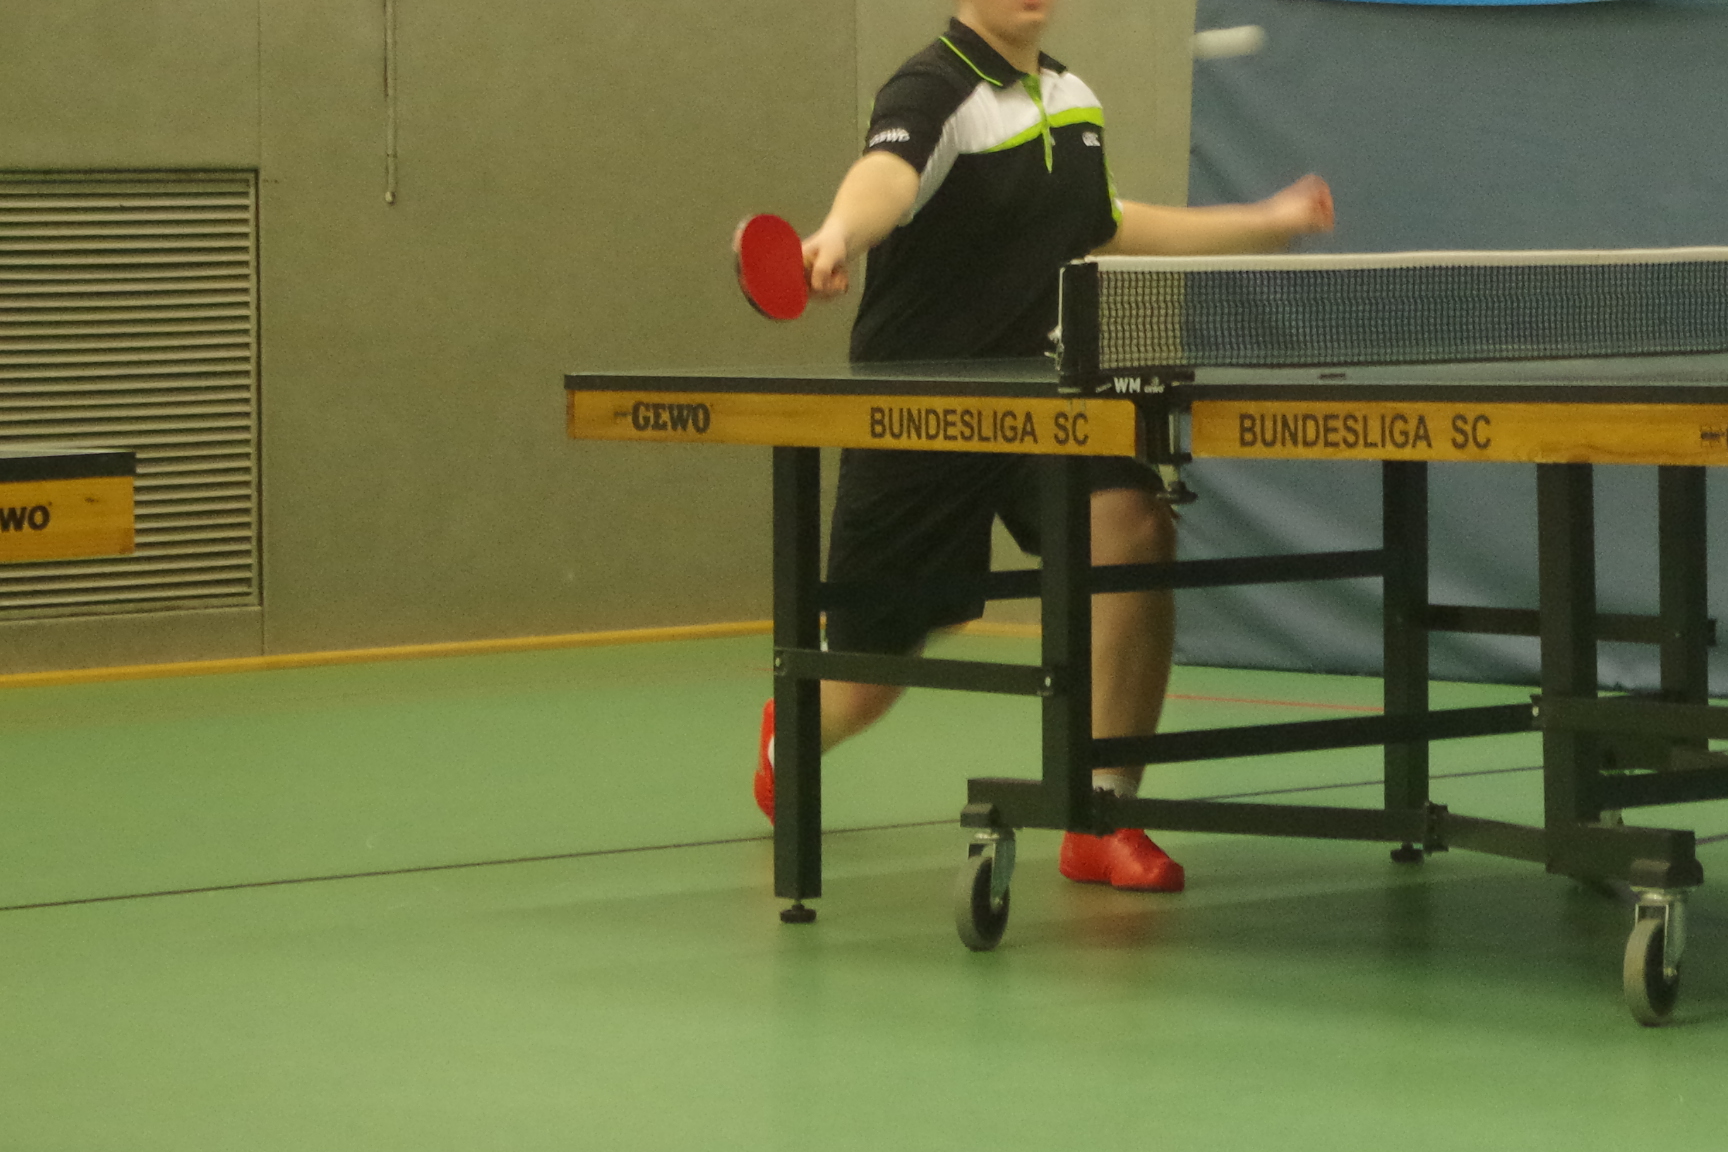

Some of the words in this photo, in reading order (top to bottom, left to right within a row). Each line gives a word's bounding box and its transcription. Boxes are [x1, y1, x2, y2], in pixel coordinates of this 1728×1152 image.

[1113, 377, 1141, 393] WM
[631, 401, 711, 434] GEWO
[869, 406, 1038, 445] BUNDESLIGA
[1053, 411, 1089, 446] SC
[1238, 413, 1432, 449] BUNDESLIGA
[1450, 414, 1491, 450] SC
